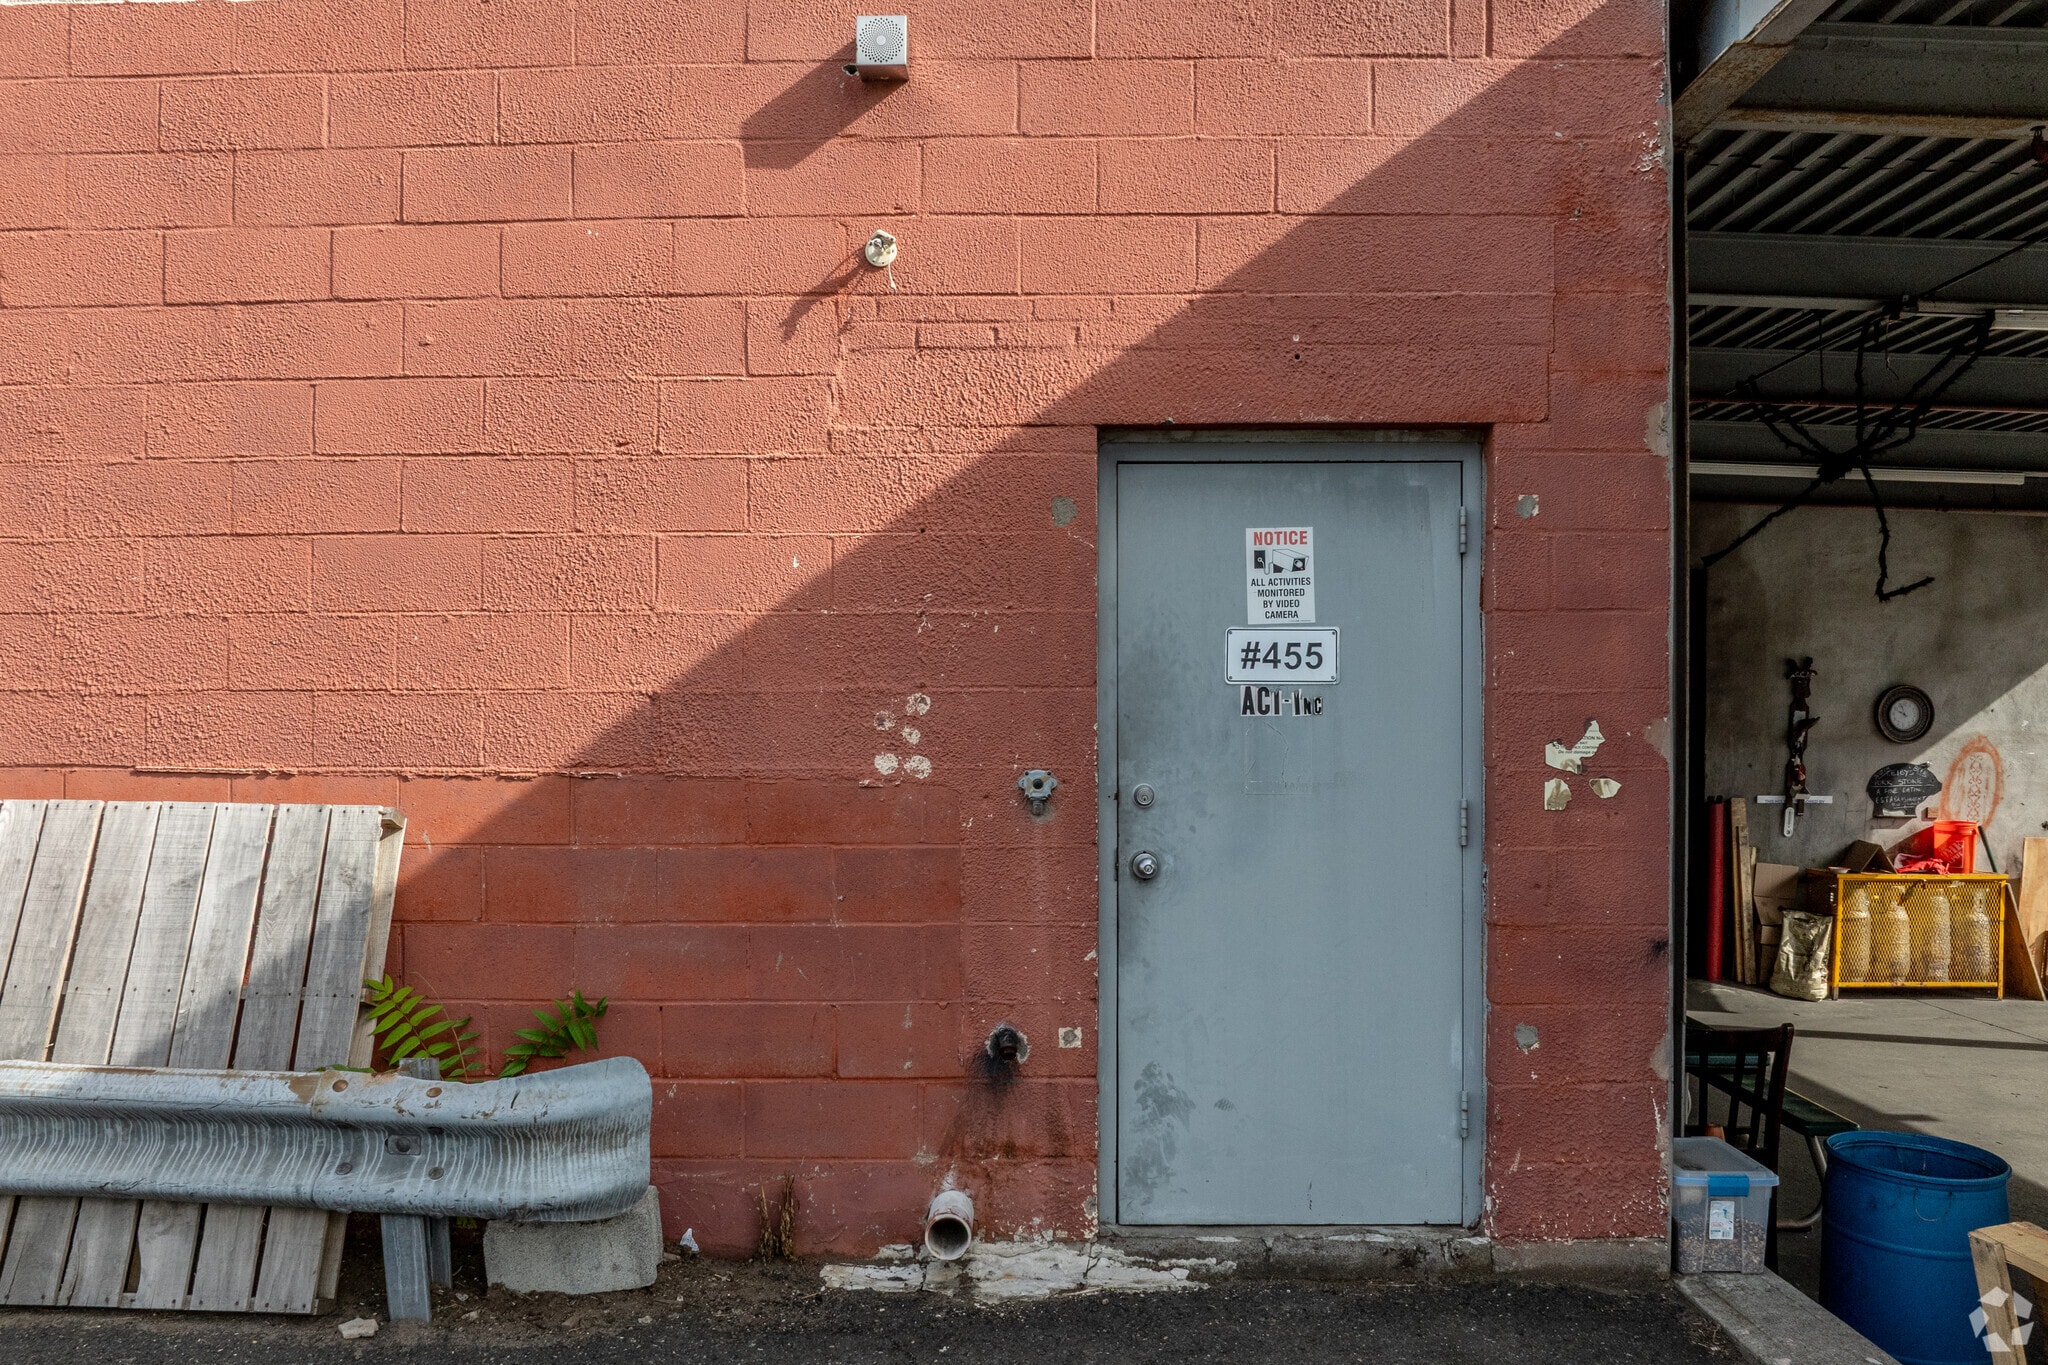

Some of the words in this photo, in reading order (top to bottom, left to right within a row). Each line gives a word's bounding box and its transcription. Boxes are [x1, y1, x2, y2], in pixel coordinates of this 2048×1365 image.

[1253, 530, 1308, 546] NOTICE
[1250, 578, 1265, 587] ALL
[1268, 577, 1311, 586] ACTIVITIES
[1257, 588, 1305, 598] MONITORED
[1263, 600, 1273, 608] BY
[1275, 599, 1300, 608] VIDEO
[1264, 610, 1299, 619] CAMERA
[1240, 641, 1324, 670] #455
